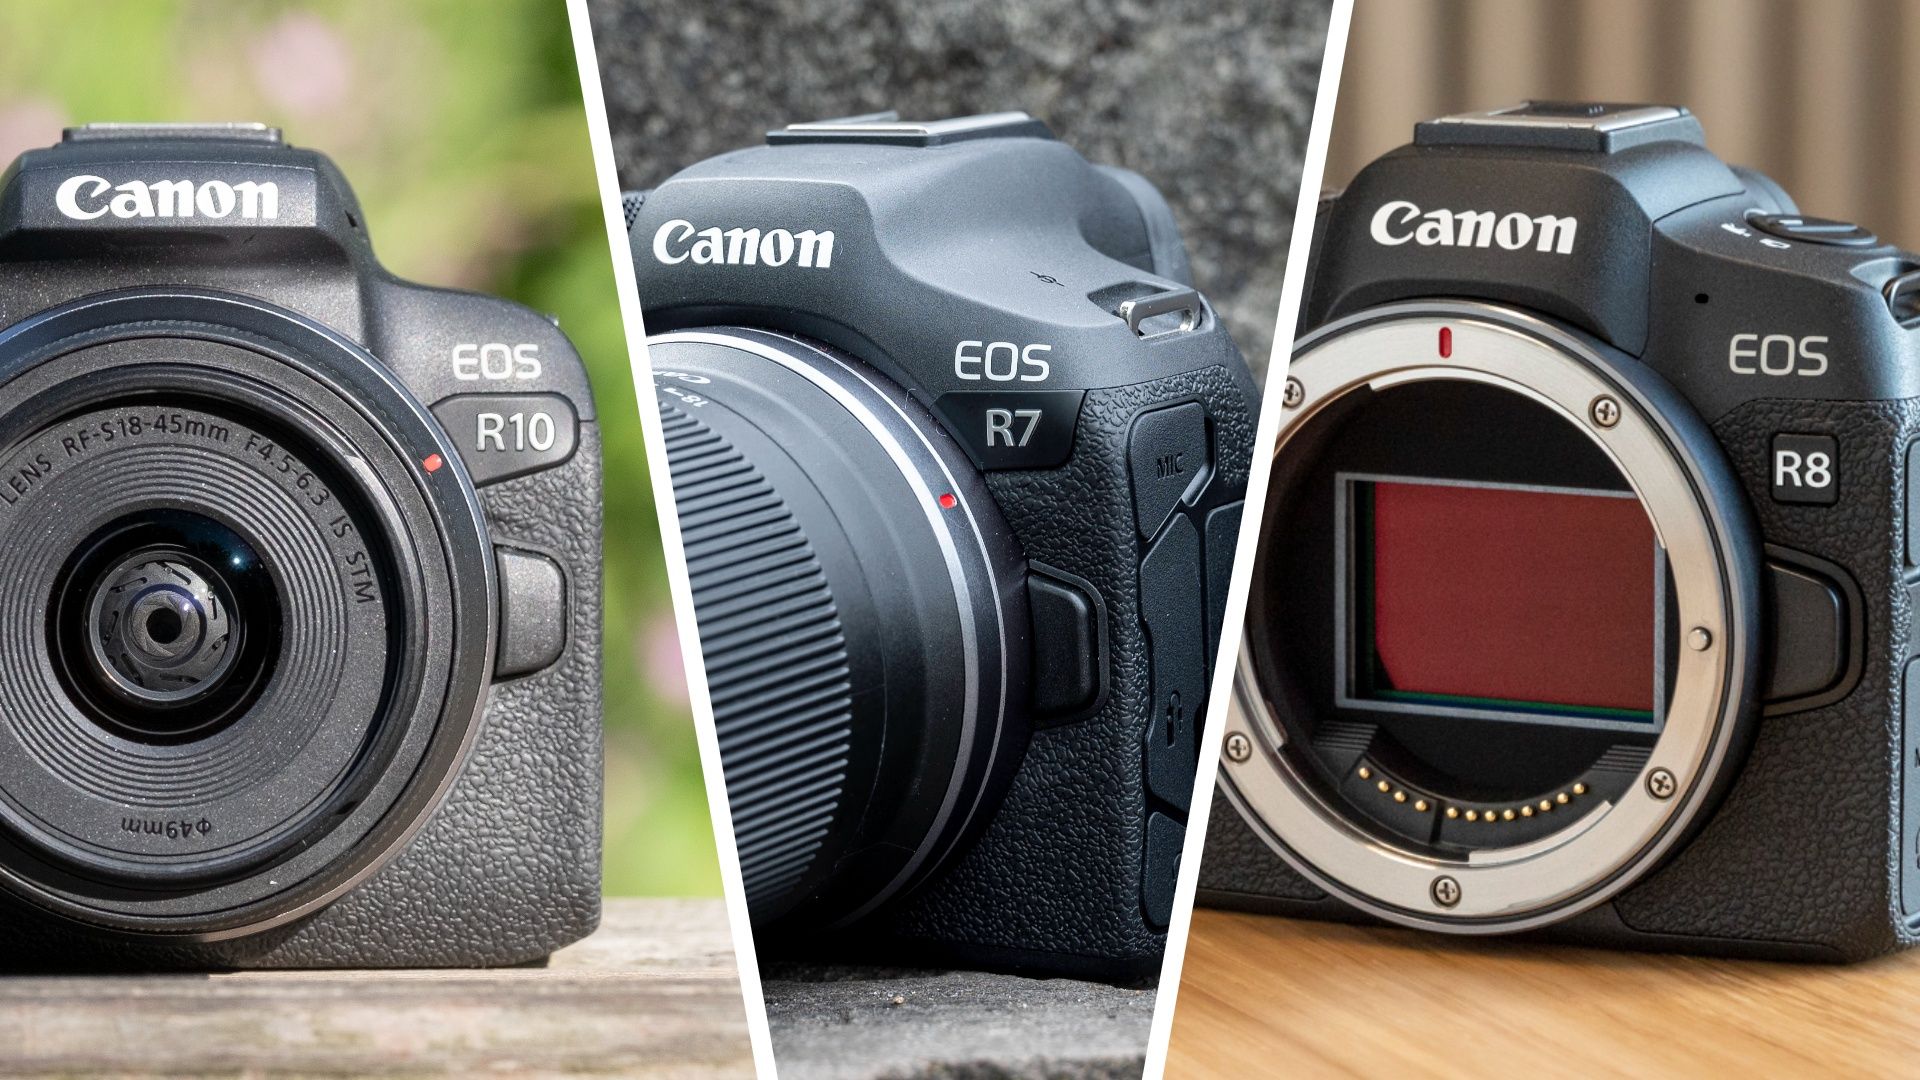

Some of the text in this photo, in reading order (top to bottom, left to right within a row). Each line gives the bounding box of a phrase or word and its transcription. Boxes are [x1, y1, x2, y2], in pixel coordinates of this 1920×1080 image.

[56, 175, 279, 220] Canon
[653, 219, 835, 269] Canon
[1370, 200, 1578, 255] Canon
[452, 343, 542, 380] EOS
[954, 340, 1052, 382] EOS
[1728, 334, 1829, 377] EOS
[475, 412, 556, 452] R10
[986, 408, 1042, 447] R7
[1157, 452, 1185, 478] MIC
[1775, 450, 1832, 488] R8
[0, 414, 376, 603] LENS RF-S18-45mm F4.5-6.3 IS STM
